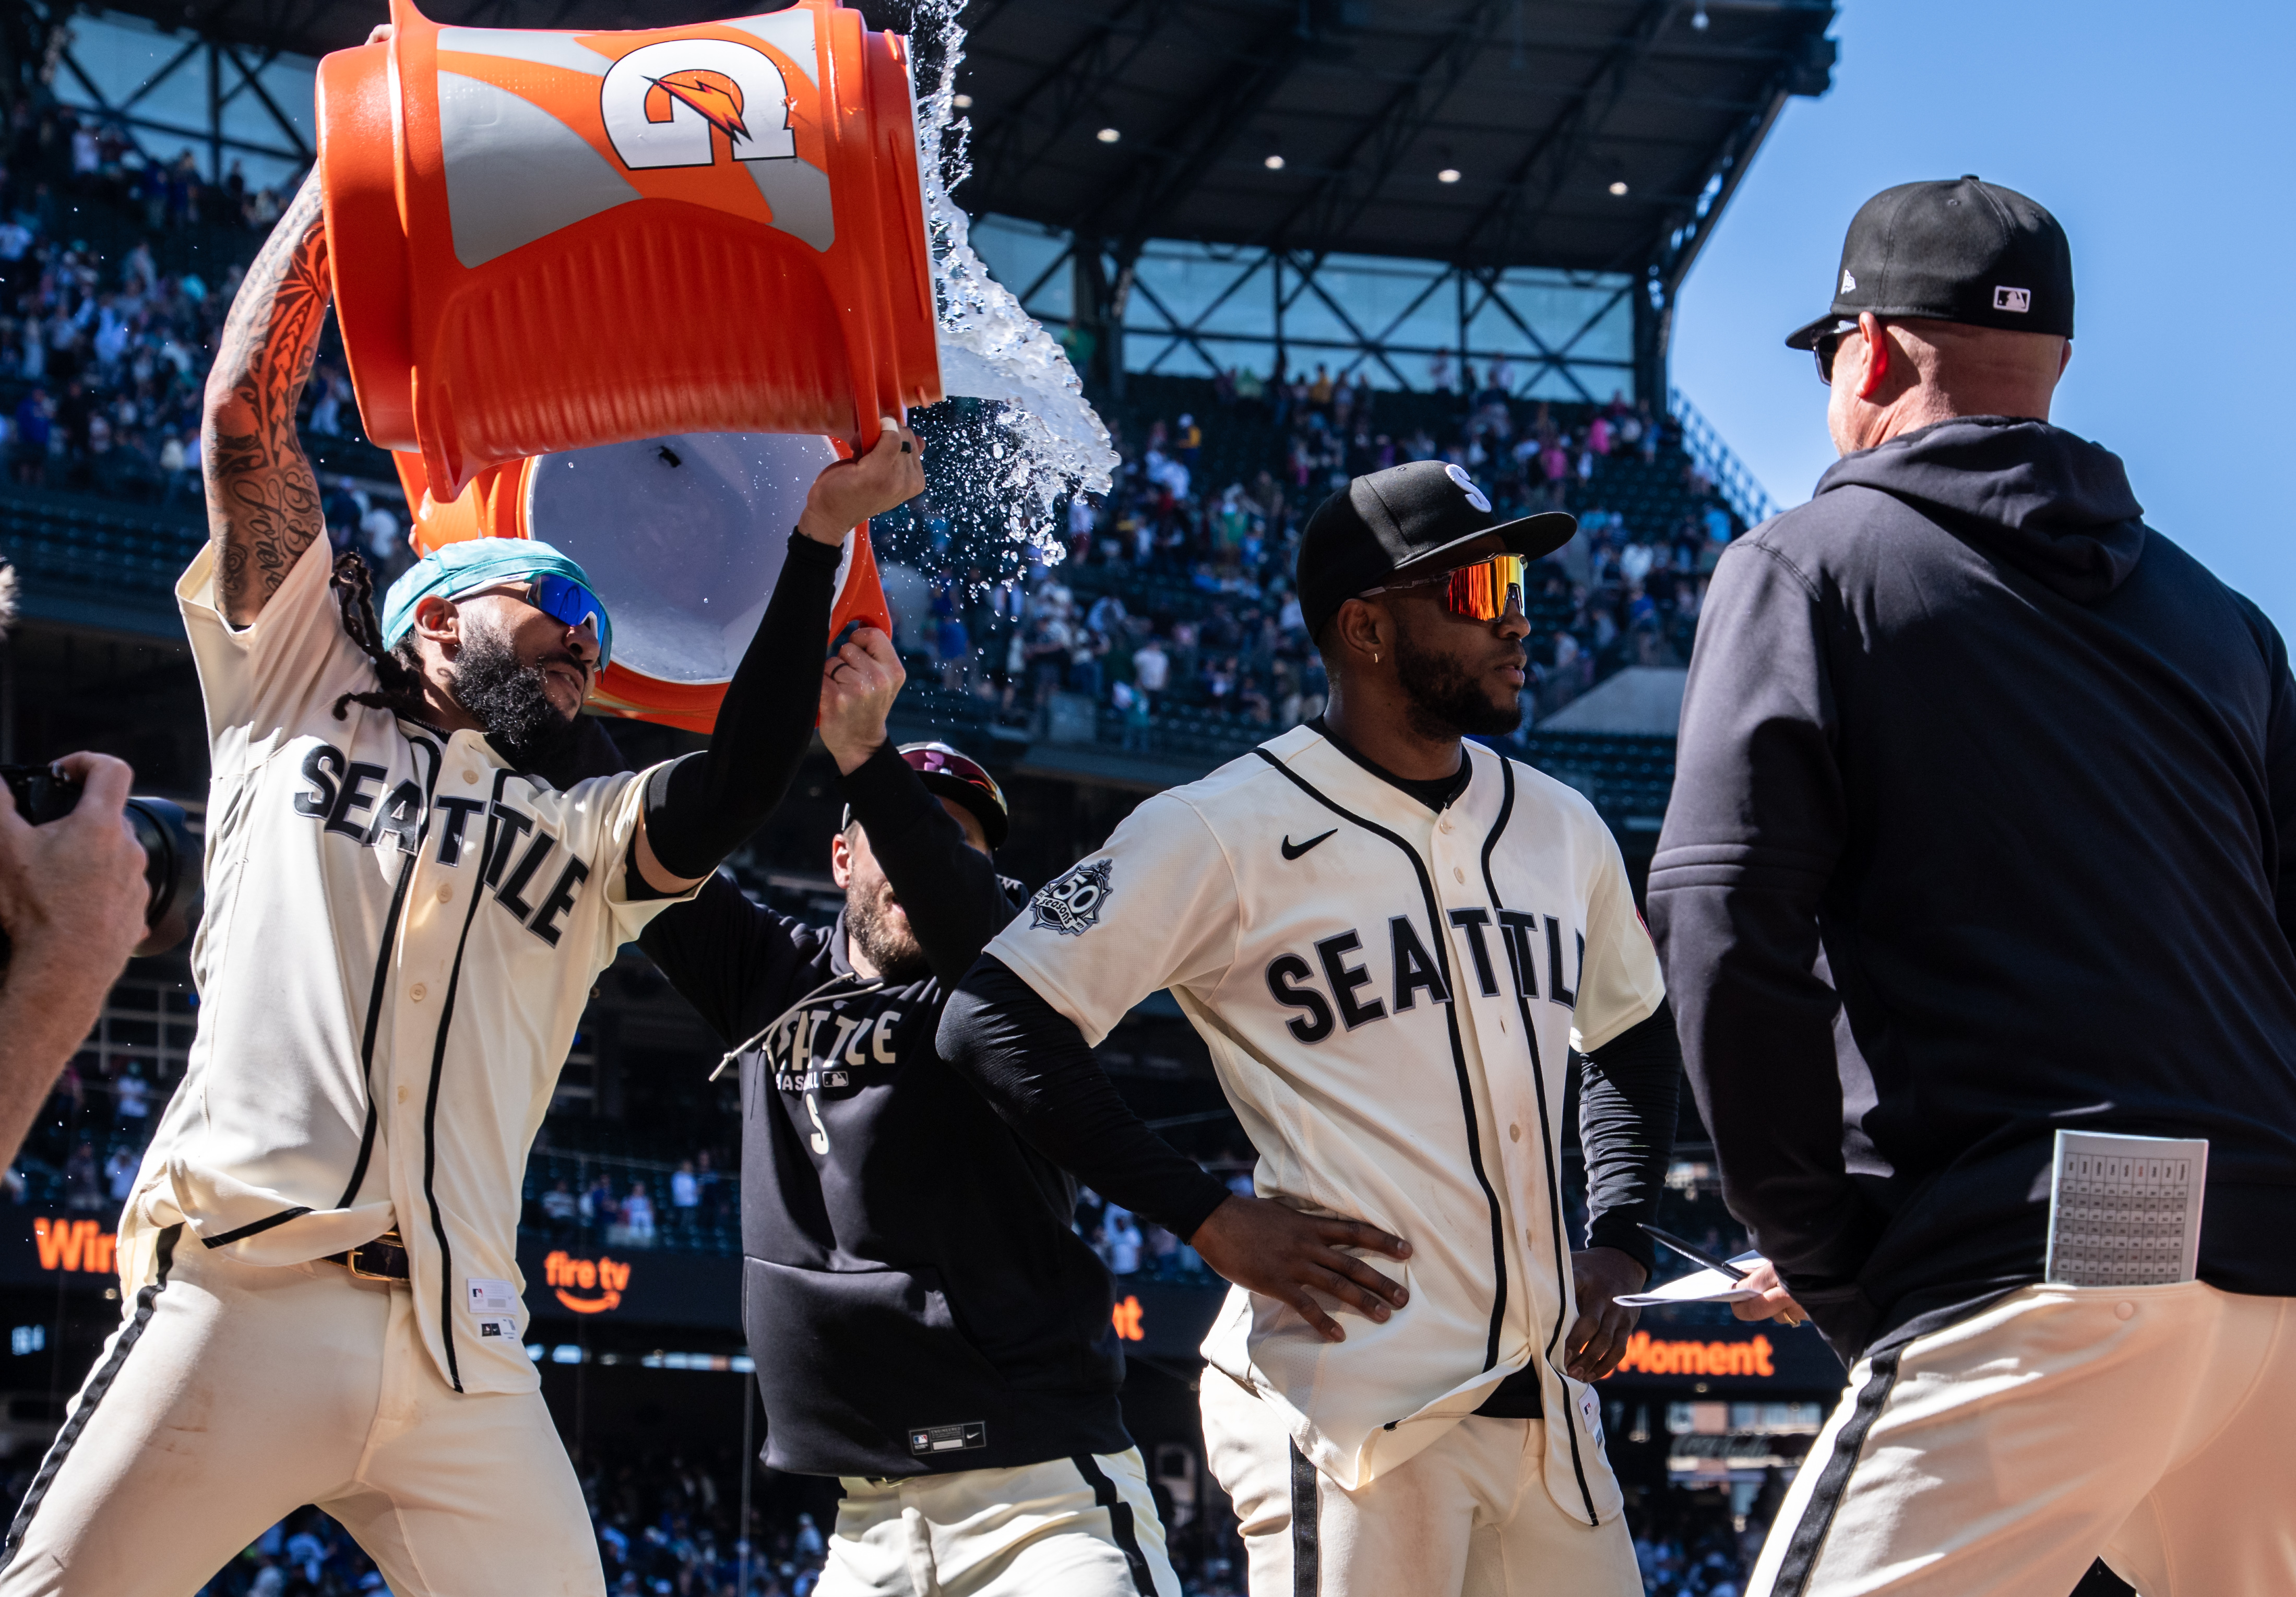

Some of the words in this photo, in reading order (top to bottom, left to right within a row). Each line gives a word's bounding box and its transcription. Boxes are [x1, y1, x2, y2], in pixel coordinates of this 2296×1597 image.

[1445, 463, 1492, 513] S
[293, 744, 590, 949] SEATTLE
[1040, 899, 1073, 925] seasons
[1053, 873, 1100, 914] 50
[806, 1093, 830, 1155] S
[544, 1250, 597, 1289] fire
[598, 1256, 631, 1291] tv
[1618, 1330, 1775, 1377] Moment
